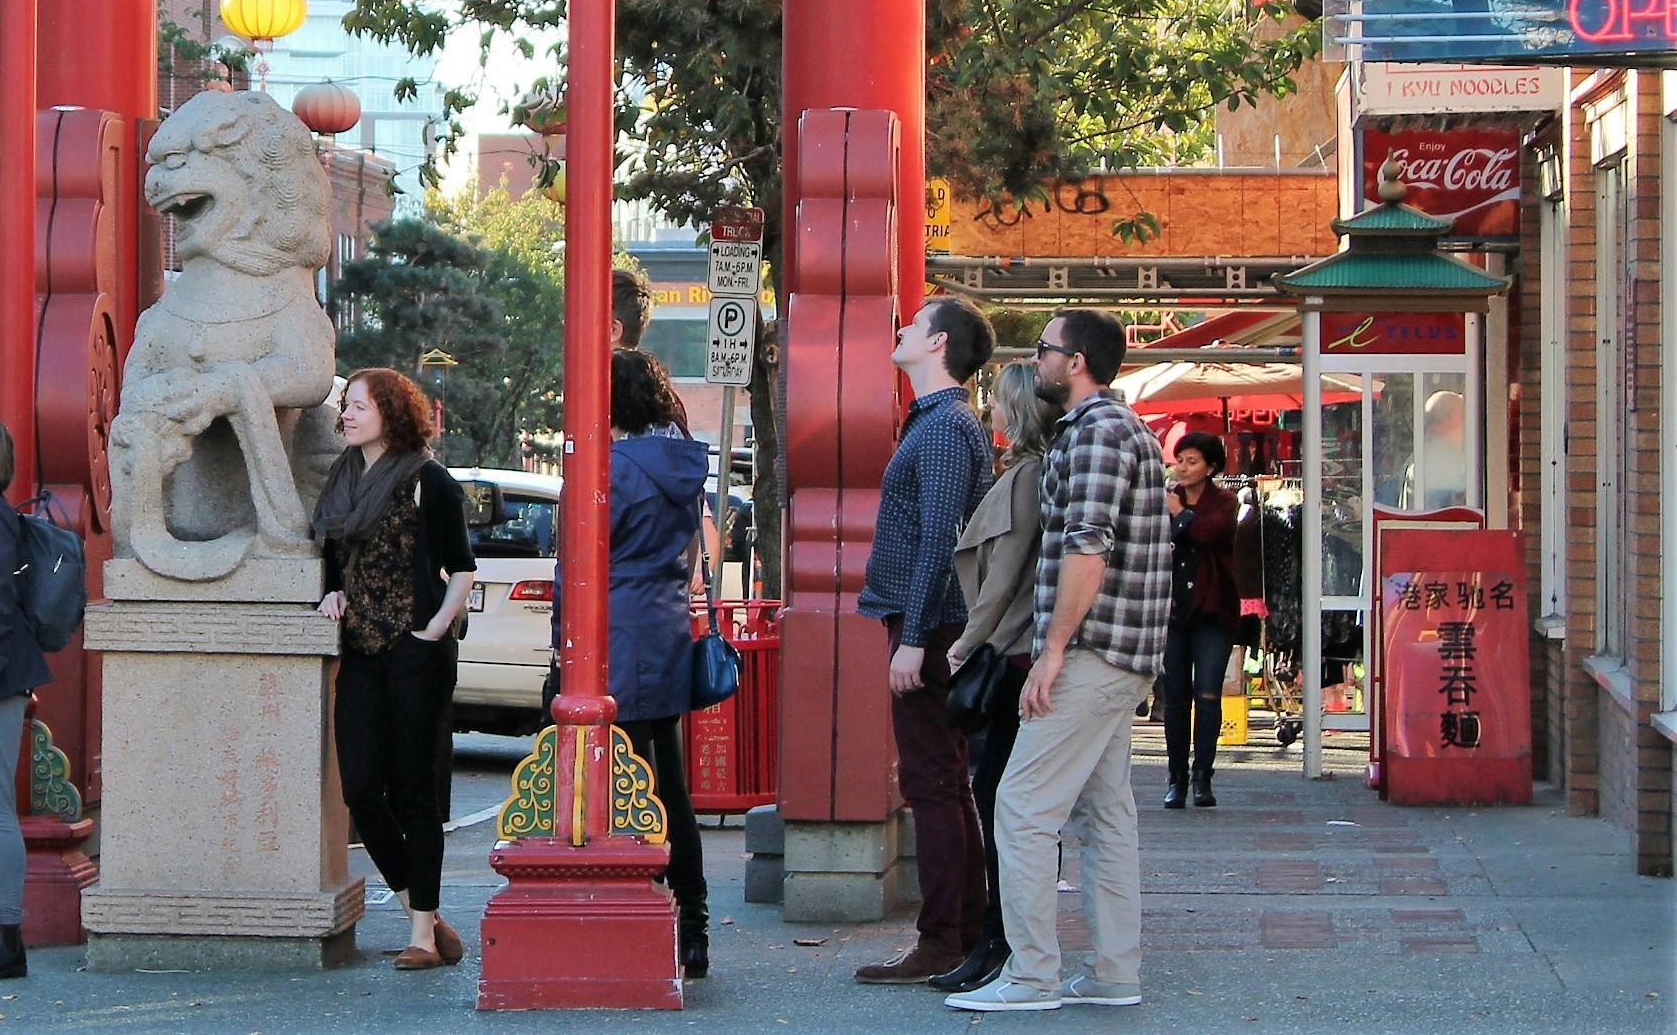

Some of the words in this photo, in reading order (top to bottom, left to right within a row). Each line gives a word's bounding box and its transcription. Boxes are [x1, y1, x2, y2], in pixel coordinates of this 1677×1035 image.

[1402, 79, 1442, 97] KYU
[1450, 77, 1541, 97] NOODLES
[1419, 142, 1446, 153] Enjoy
[1377, 147, 1518, 191] Coca-Cola
[720, 246, 751, 259] LOADING
[1385, 324, 1460, 340] TELUS
[712, 365, 744, 378] SATURDAY
